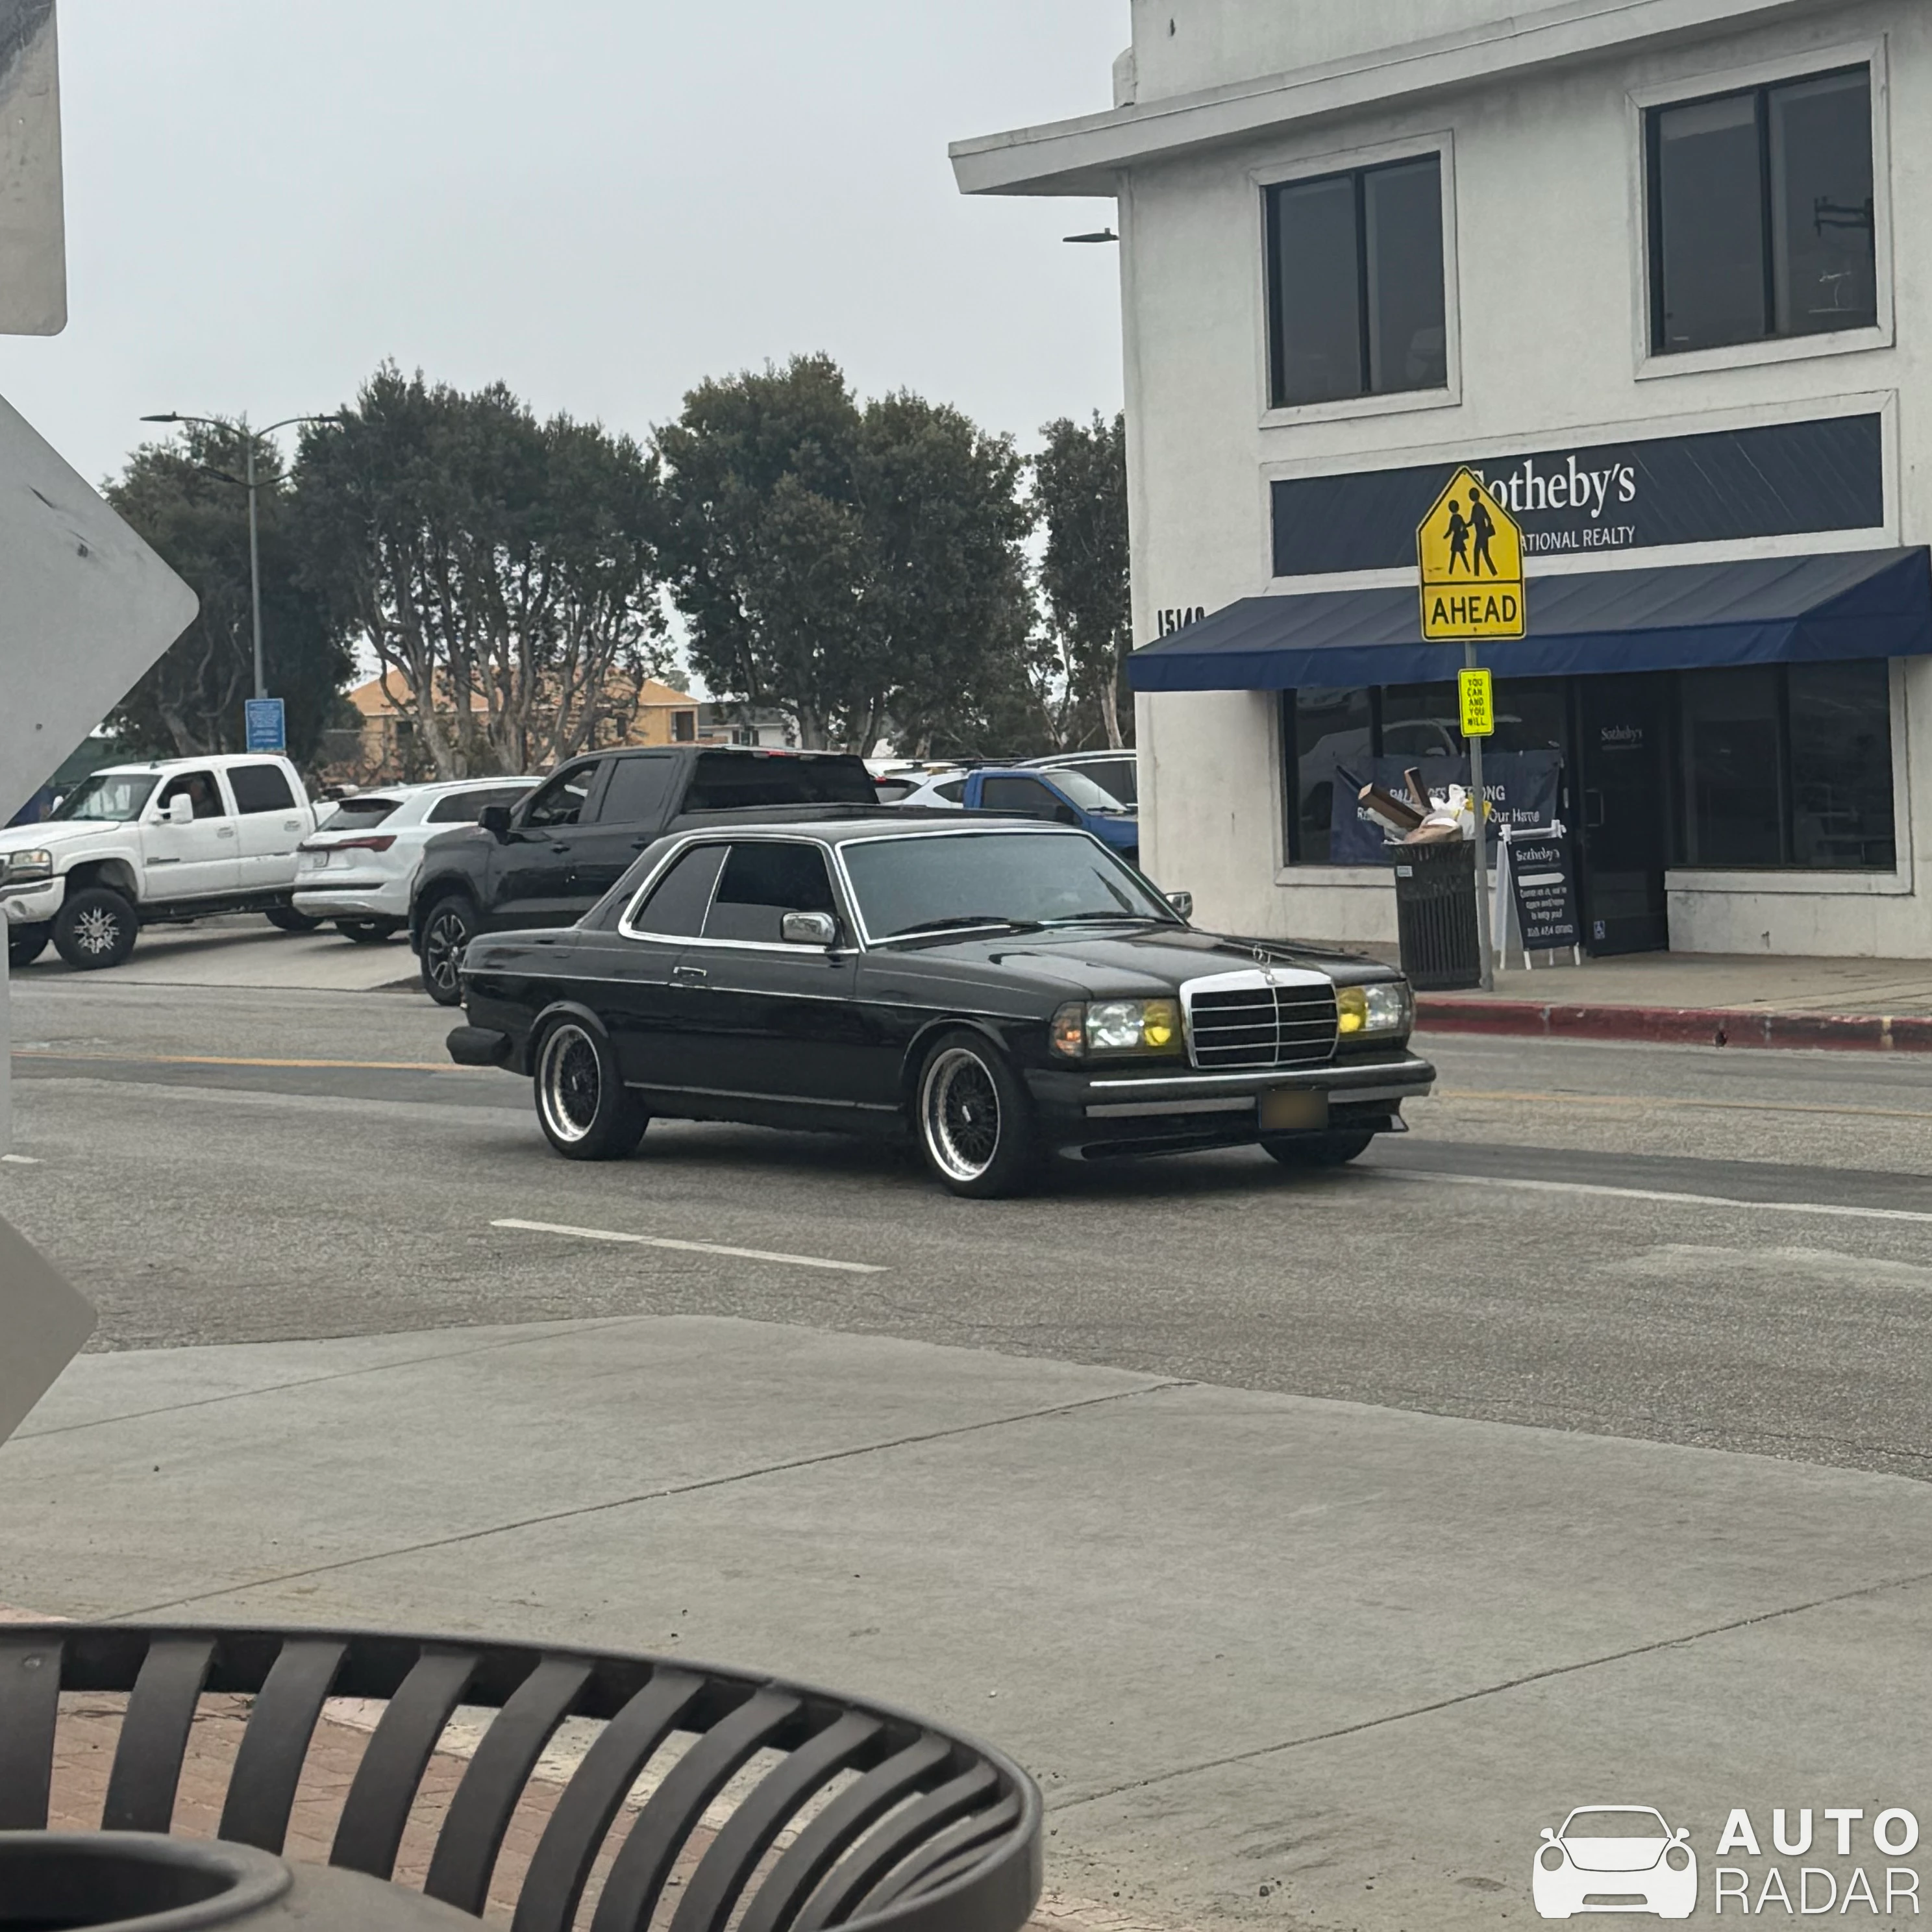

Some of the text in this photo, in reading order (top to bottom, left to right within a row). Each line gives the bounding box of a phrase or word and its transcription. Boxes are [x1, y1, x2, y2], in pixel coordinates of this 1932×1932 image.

[1472, 455, 1636, 519] otheby's
[1522, 526, 1635, 551] ATIONAL REALTY
[1431, 595, 1517, 625] AHEAD
[1468, 678, 1483, 687] YOU
[1467, 687, 1483, 697] CAN
[1469, 697, 1484, 706] AND
[1469, 707, 1485, 716] YOU
